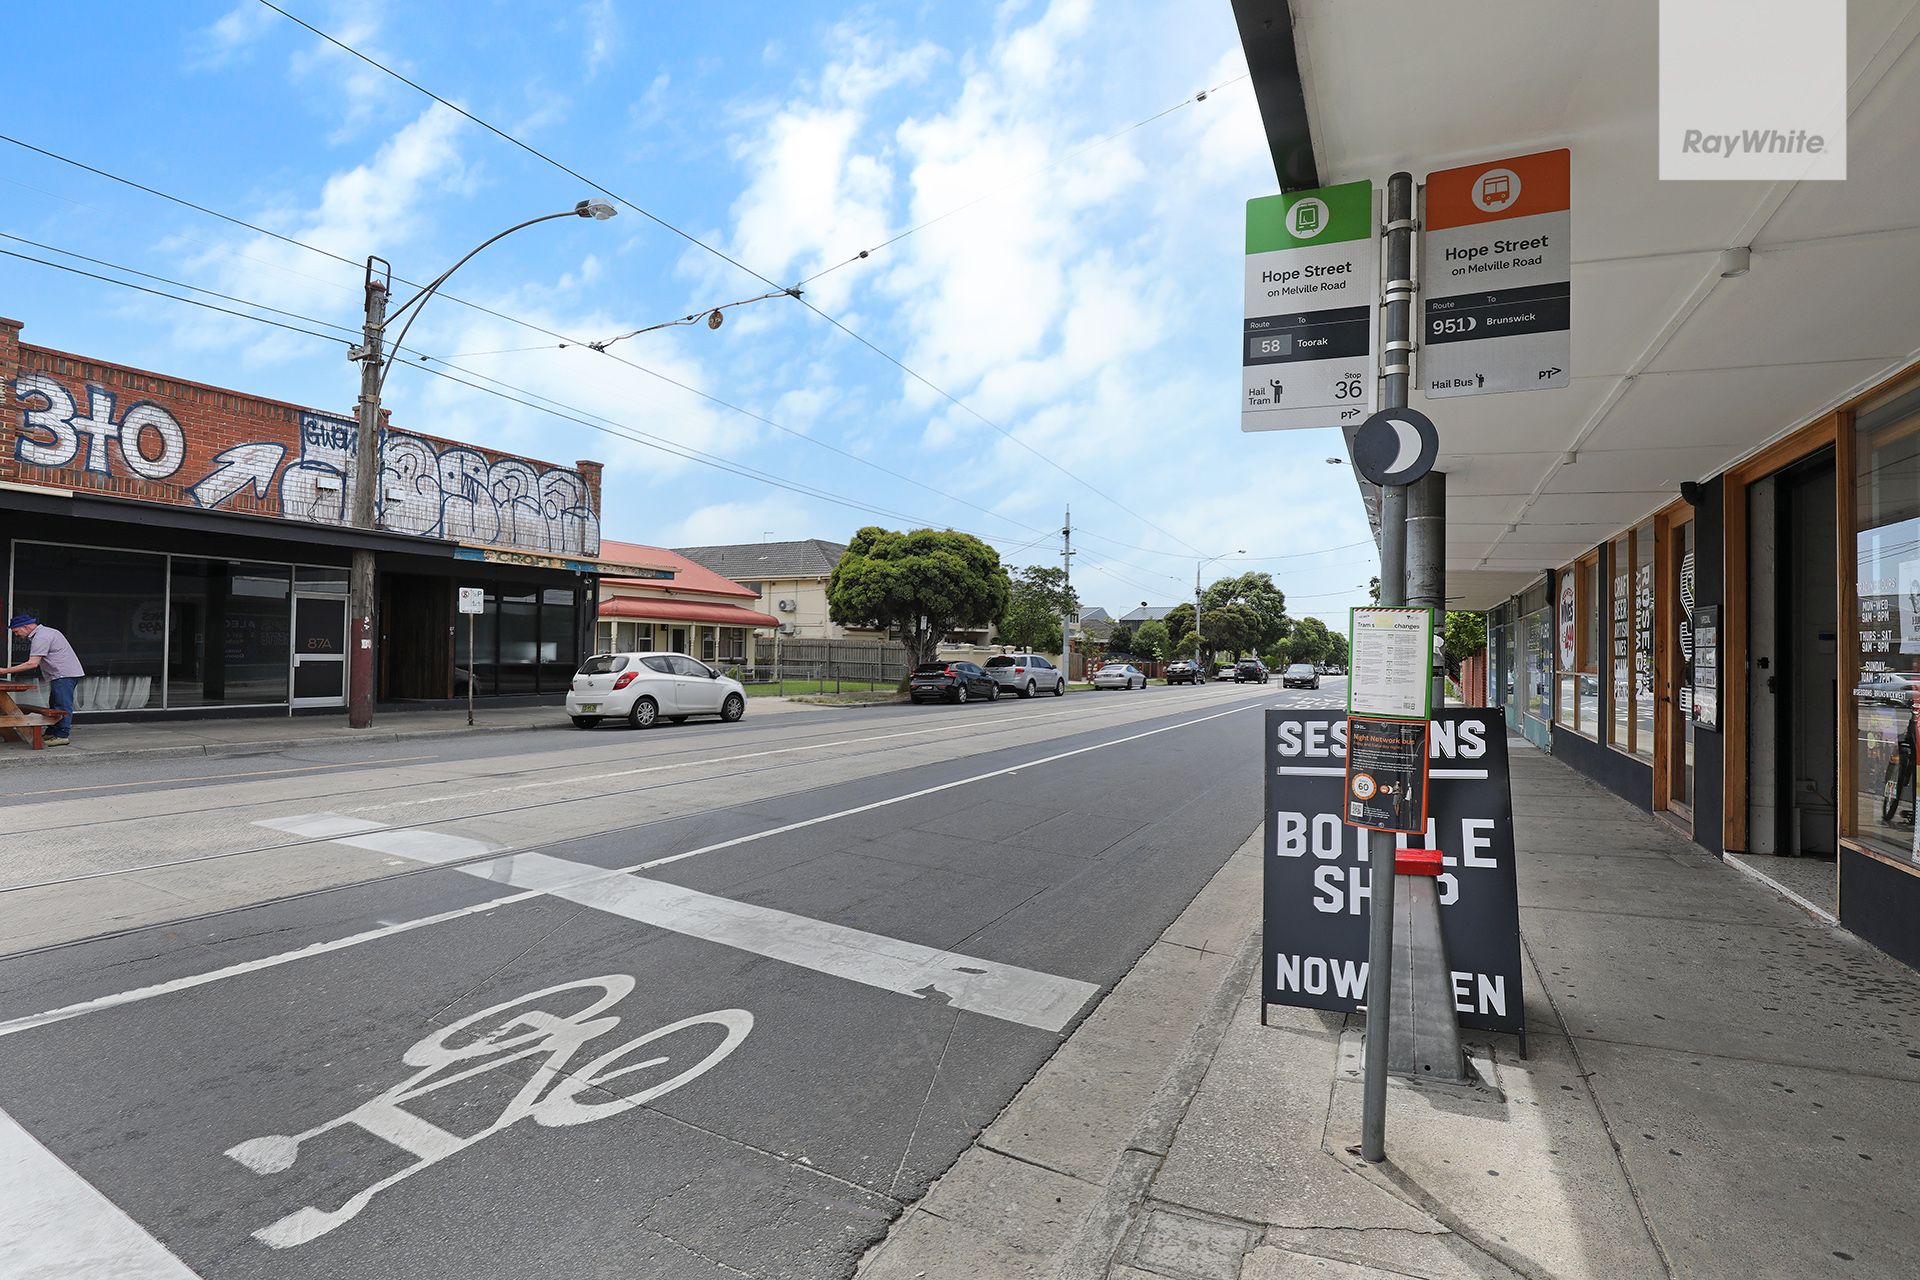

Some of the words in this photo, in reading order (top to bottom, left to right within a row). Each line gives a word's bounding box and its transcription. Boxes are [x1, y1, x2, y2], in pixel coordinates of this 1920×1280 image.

[1445, 245, 1489, 261] Hope
[1494, 234, 1549, 254] Street
[1262, 270, 1300, 283] Hope
[1304, 261, 1352, 278] Street
[1451, 266, 1466, 276] on
[1468, 260, 1510, 273] Melville
[1512, 255, 1542, 268] Road
[1267, 289, 1280, 298] on
[1281, 284, 1319, 295] Melville
[1320, 280, 1347, 291] Road
[1432, 301, 1455, 310] Route
[1487, 295, 1497, 303] To
[1250, 321, 1270, 329] Route
[1486, 312, 1536, 326] Brunswick
[1261, 339, 1280, 353] 58
[1297, 337, 1328, 347] Toorak
[1344, 372, 1362, 380] Stop
[1334, 380, 1362, 399] 36
[1431, 379, 1452, 389] Hail
[1453, 378, 1473, 387] Bus
[1248, 387, 1266, 396] Hail
[1248, 397, 1271, 406] Tram
[1881, 630, 1893, 641] SAT
[1358, 782, 1369, 791] 60
[1276, 953, 1370, 1001] NOW
